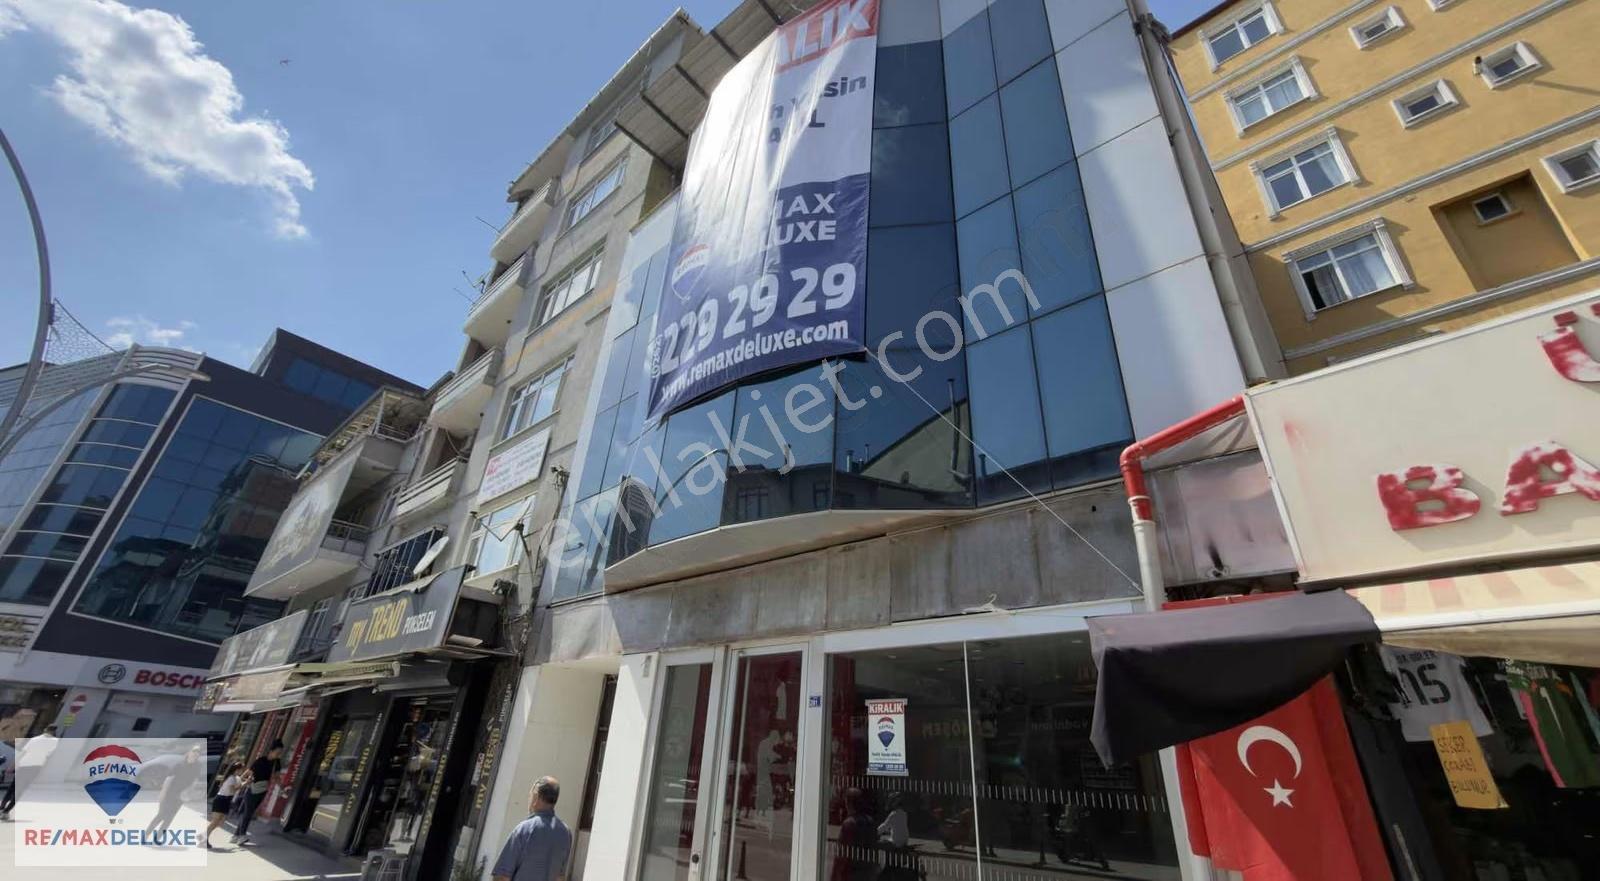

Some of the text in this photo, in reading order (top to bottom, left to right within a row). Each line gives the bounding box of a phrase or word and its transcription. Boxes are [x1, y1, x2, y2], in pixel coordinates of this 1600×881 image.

[661, 262, 857, 376] 229 29 29
[346, 619, 369, 657] my
[364, 597, 408, 644] TREND
[134, 668, 208, 690] BOSCH
[481, 727, 500, 780] TREND
[475, 783, 489, 809] my
